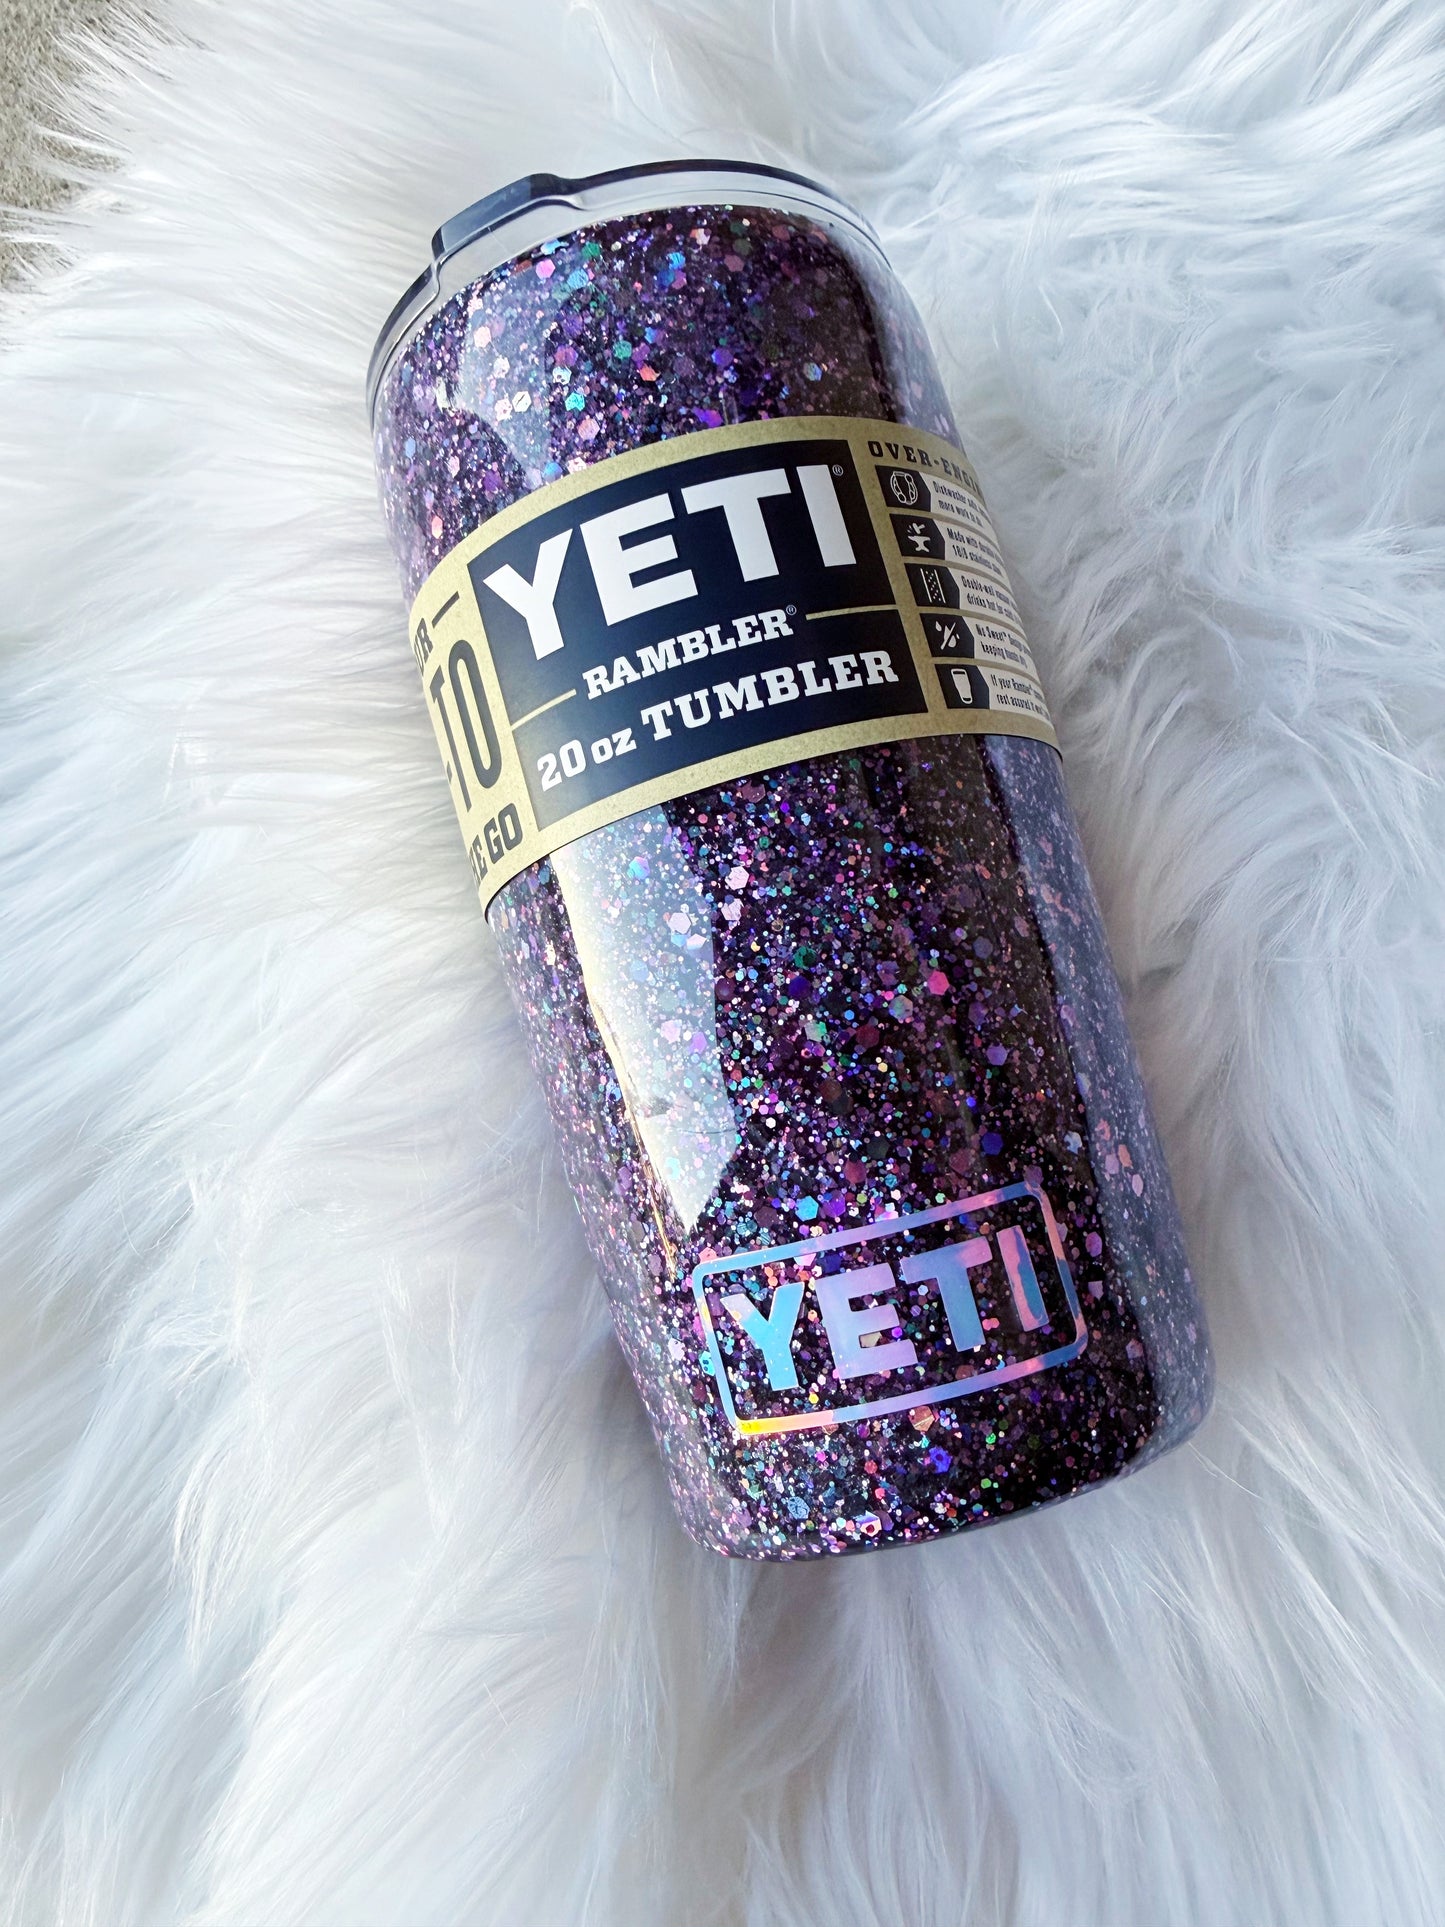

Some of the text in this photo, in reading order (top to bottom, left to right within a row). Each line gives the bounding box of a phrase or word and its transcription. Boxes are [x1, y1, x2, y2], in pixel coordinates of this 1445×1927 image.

[537, 650, 899, 791] 20 oz TUMBLER
[484, 803, 523, 864] GO
[720, 1225, 1049, 1391] YETI
